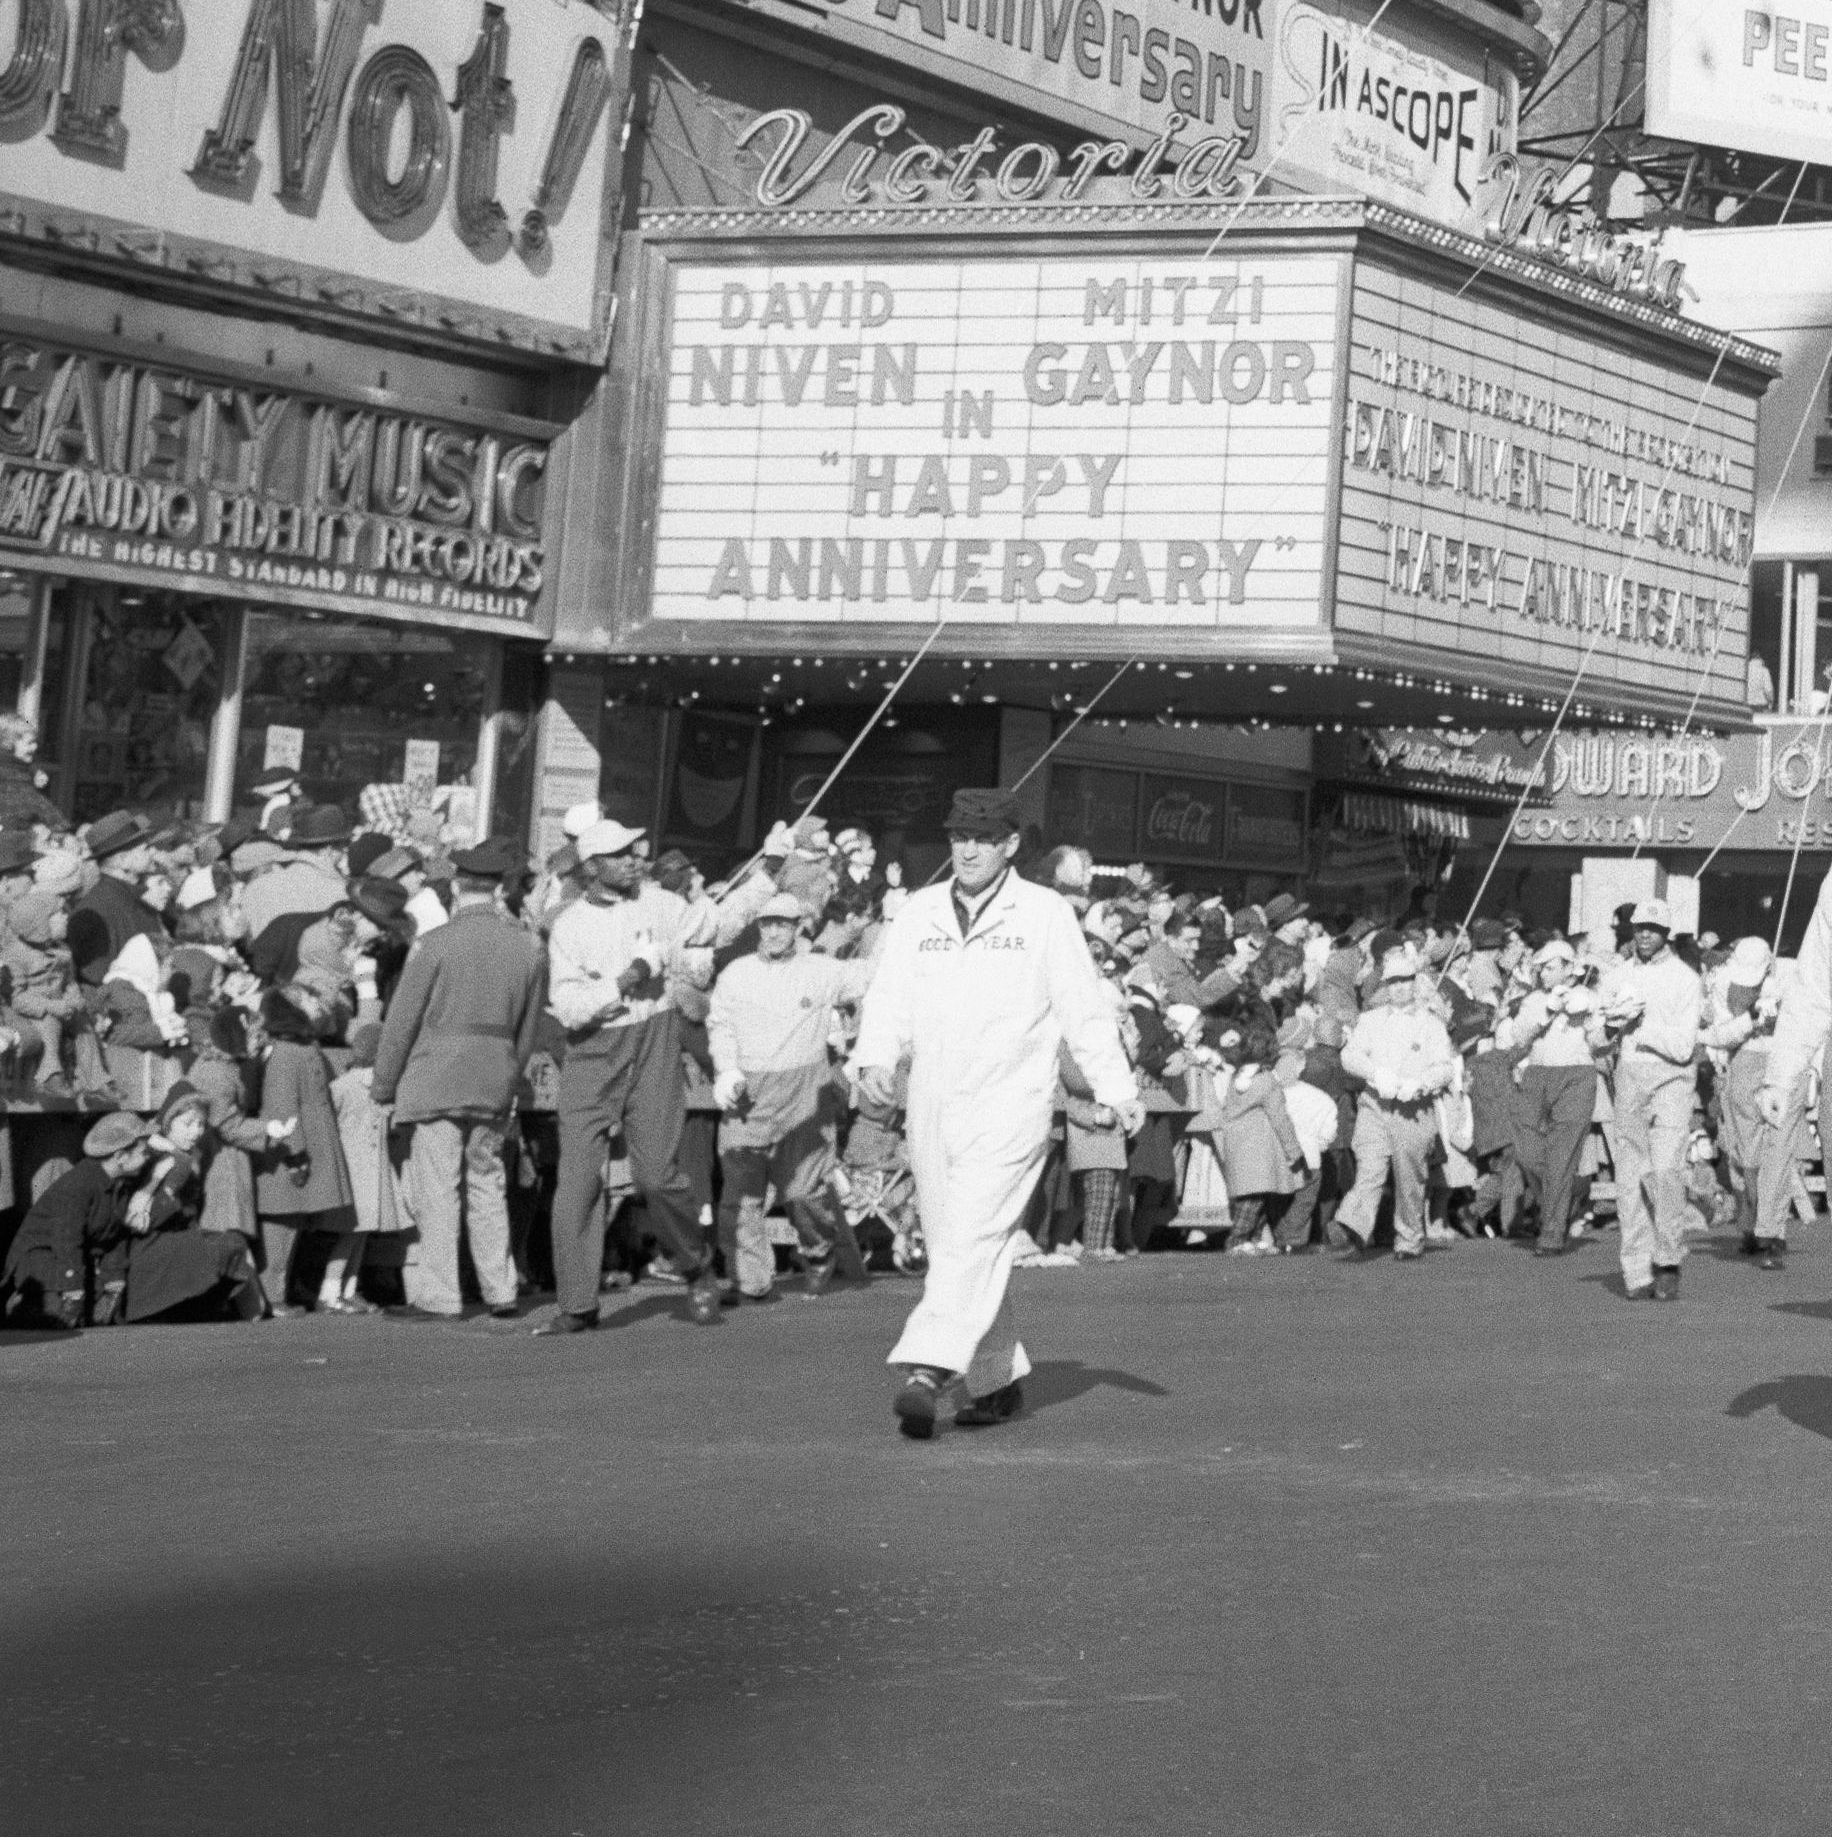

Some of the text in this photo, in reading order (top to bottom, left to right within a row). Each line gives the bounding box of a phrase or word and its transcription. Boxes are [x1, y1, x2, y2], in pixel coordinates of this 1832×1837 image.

[736, 104, 1255, 206] Victoria
[1318, 30, 1350, 112] IN
[1357, 66, 1478, 208] ASCOPE
[719, 275, 1264, 329] DAVID MITZI
[688, 340, 1317, 407] NIVEN GAYNOR
[943, 389, 995, 439] IN
[306, 404, 548, 540] MUSIC
[819, 451, 1124, 519] "HAPPY
[1348, 397, 1446, 490] DAVID
[1453, 427, 1543, 513] NIVEN
[1572, 462, 1645, 543] MITZI
[60, 468, 198, 538] AUDIO
[204, 489, 368, 565] FIDELITY
[376, 519, 545, 594] RECORDS
[706, 535, 1298, 606] ANNIVERSARY"
[59, 530, 530, 620] THE HIGHEST STANDARD IN HIGH FIDELITY
[1513, 815, 1696, 842] COCKTAILS
